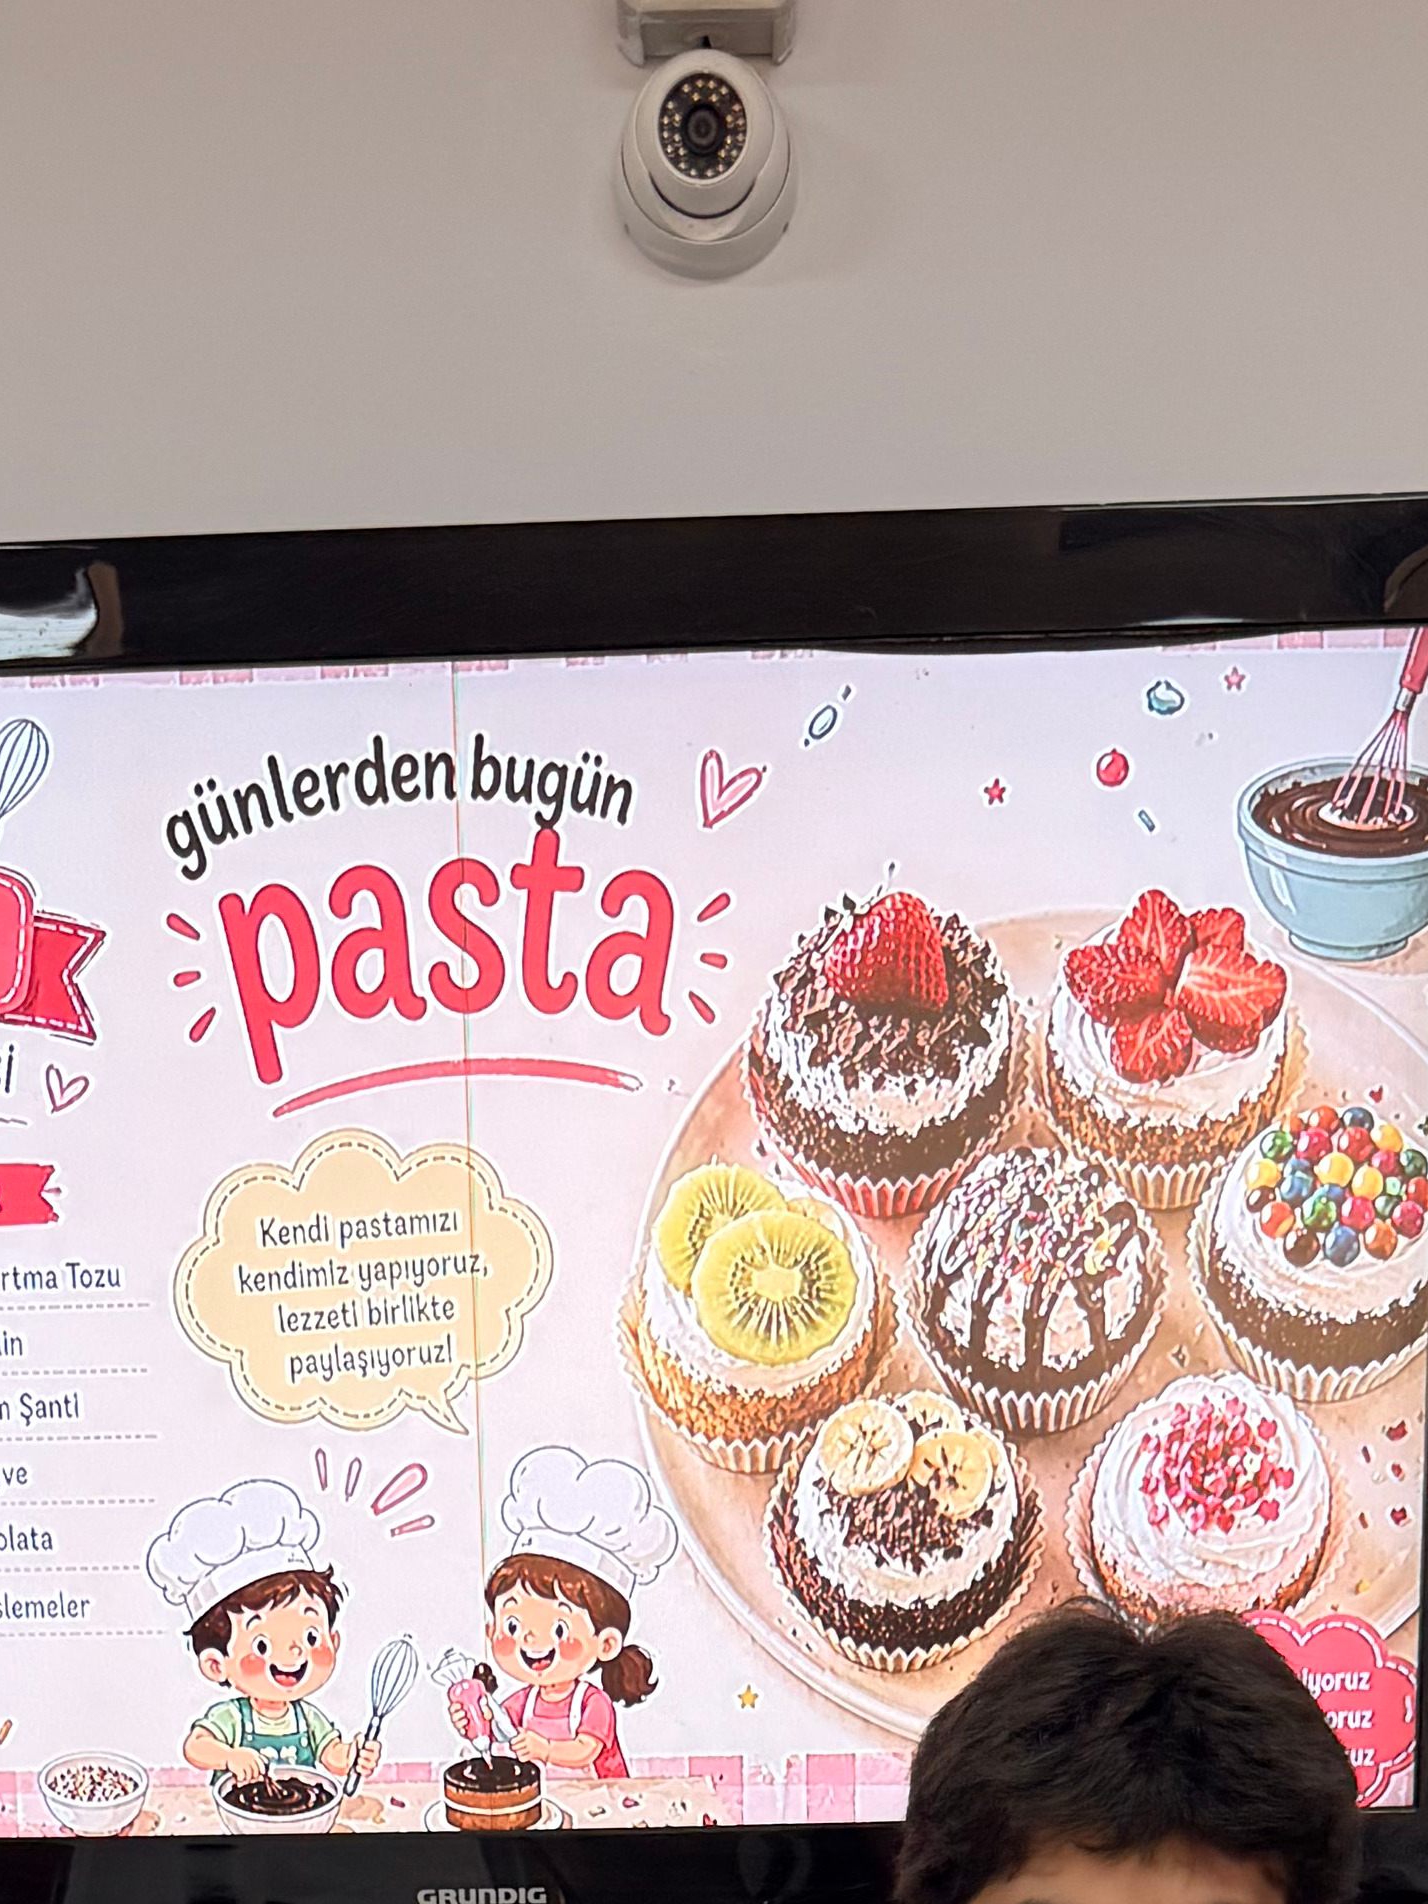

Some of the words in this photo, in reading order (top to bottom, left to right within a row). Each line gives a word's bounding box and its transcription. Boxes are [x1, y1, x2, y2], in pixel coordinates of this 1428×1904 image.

[166, 736, 456, 881] günlerden
[471, 734, 633, 827] bugün
[218, 826, 674, 1084] pasta
[261, 1215, 329, 1248] Kendi
[340, 1212, 458, 1248] pastamızı
[66, 1263, 121, 1289] Tozu
[239, 1260, 349, 1294] kendimiz
[358, 1253, 488, 1291] yapıyoruz,
[279, 1301, 359, 1333] lezzeti
[367, 1295, 455, 1327] birlikte
[290, 1334, 453, 1382] paylaşıyoruz!
[20, 1393, 79, 1425] Şanti
